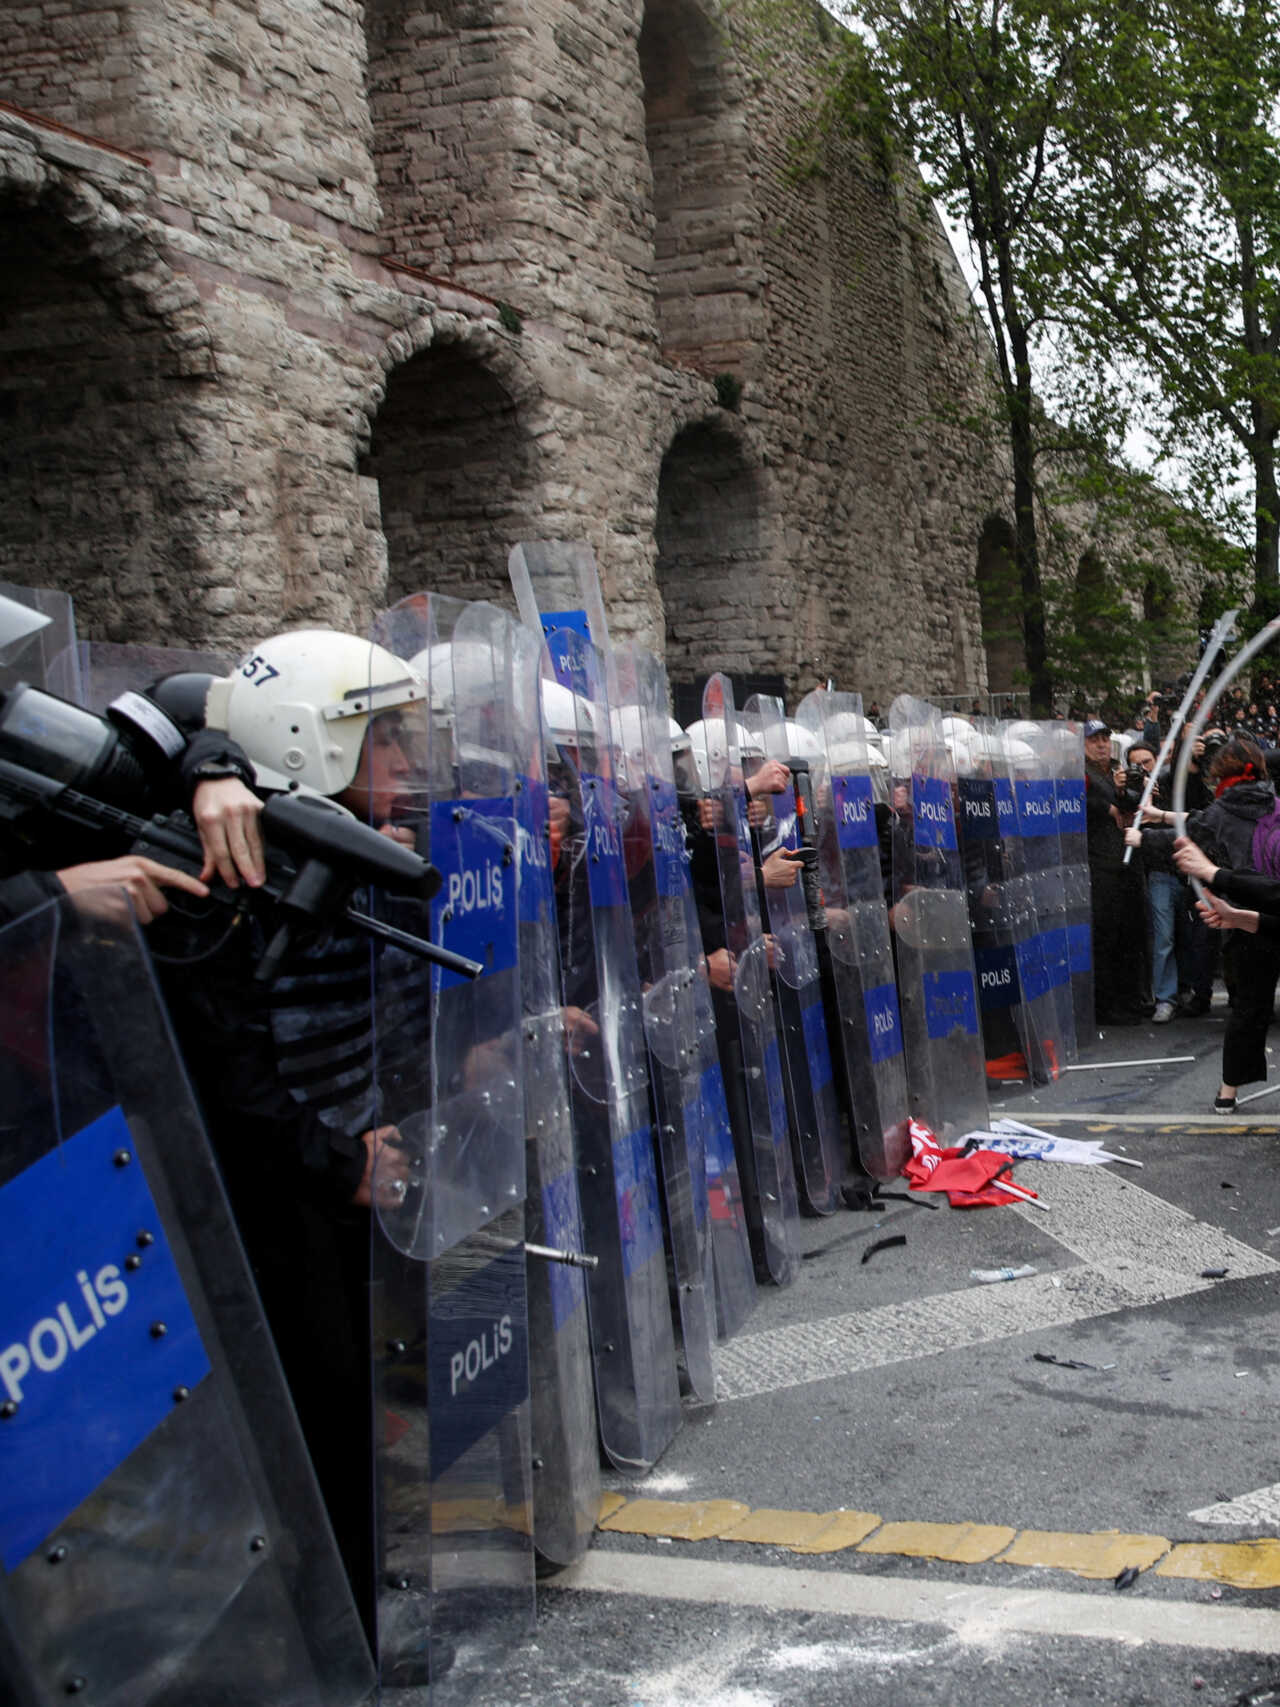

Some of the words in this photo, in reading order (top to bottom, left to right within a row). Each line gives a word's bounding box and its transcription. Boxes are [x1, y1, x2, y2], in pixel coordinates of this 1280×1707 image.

[240, 655, 281, 687] 57
[921, 800, 947, 823] POLİS
[965, 800, 991, 818] POLİS
[449, 860, 503, 914] POLİS
[981, 968, 1011, 988] POLİS
[0, 1264, 128, 1403] POLİS
[450, 1314, 512, 1396] POLİS
